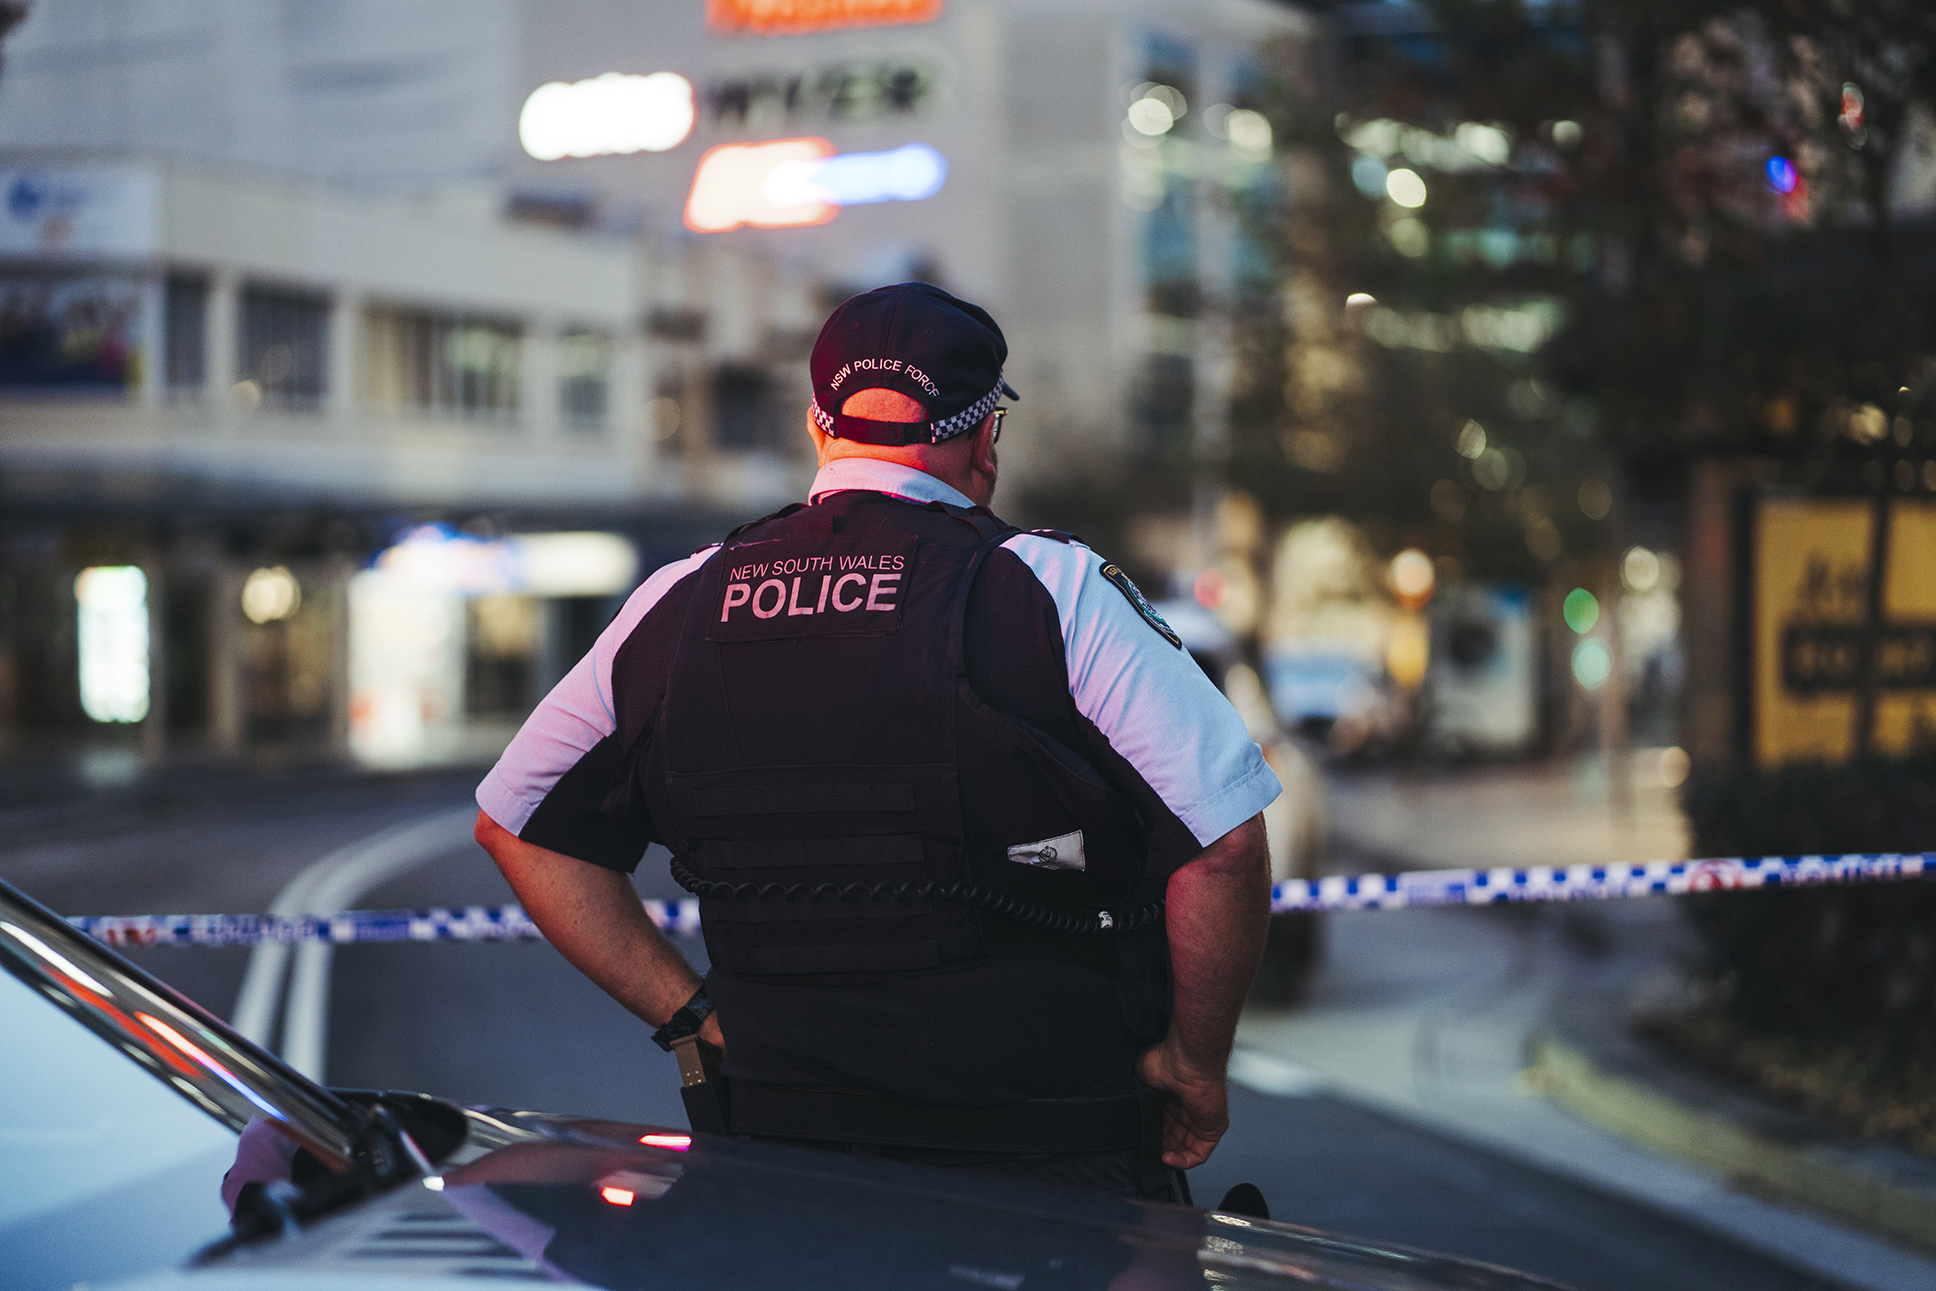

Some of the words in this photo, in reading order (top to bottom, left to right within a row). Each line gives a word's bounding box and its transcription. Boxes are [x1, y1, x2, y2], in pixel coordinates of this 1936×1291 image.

[830, 363, 852, 391] NSW
[854, 358, 903, 372] POLICE
[904, 364, 940, 397] FORCE
[729, 562, 769, 581] NEW
[771, 555, 833, 576] SOUTH
[839, 555, 905, 571] WALES
[720, 572, 902, 622] POLICE
